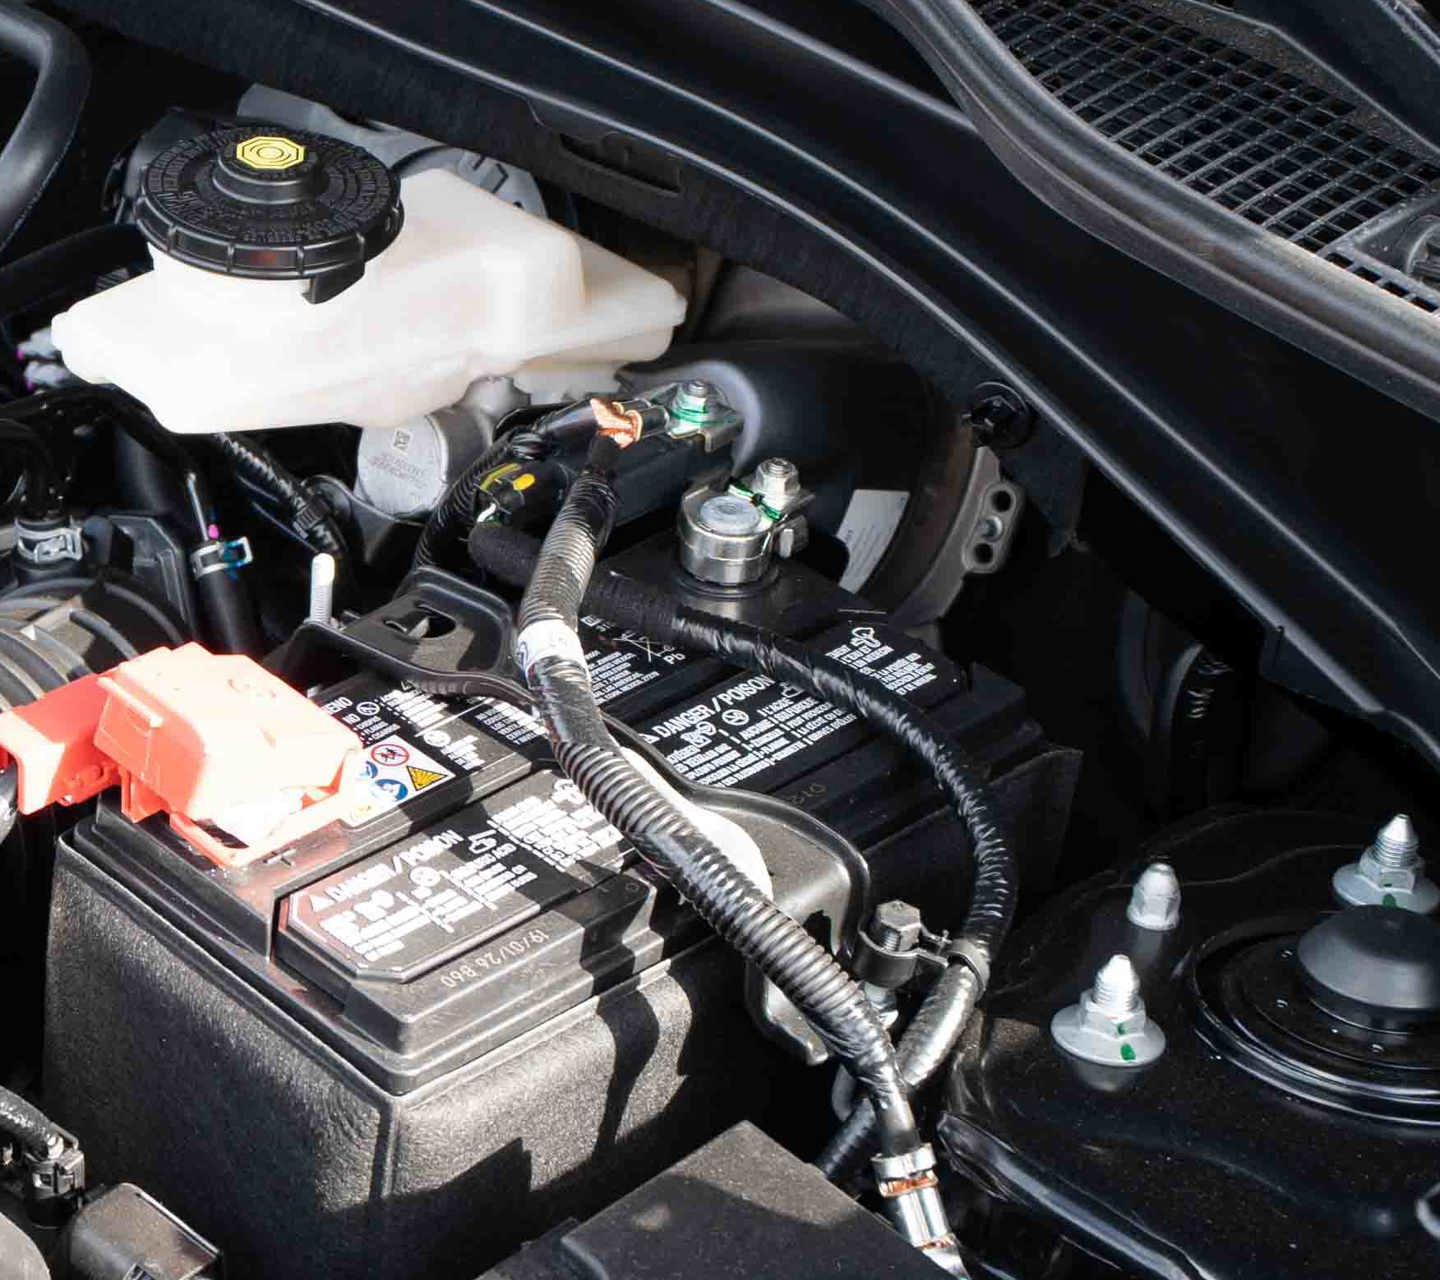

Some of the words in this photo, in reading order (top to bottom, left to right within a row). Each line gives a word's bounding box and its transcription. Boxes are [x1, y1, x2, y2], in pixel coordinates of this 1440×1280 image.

[662, 652, 686, 665] Pb
[652, 704, 717, 738] DANGER
[719, 674, 776, 706] POISON
